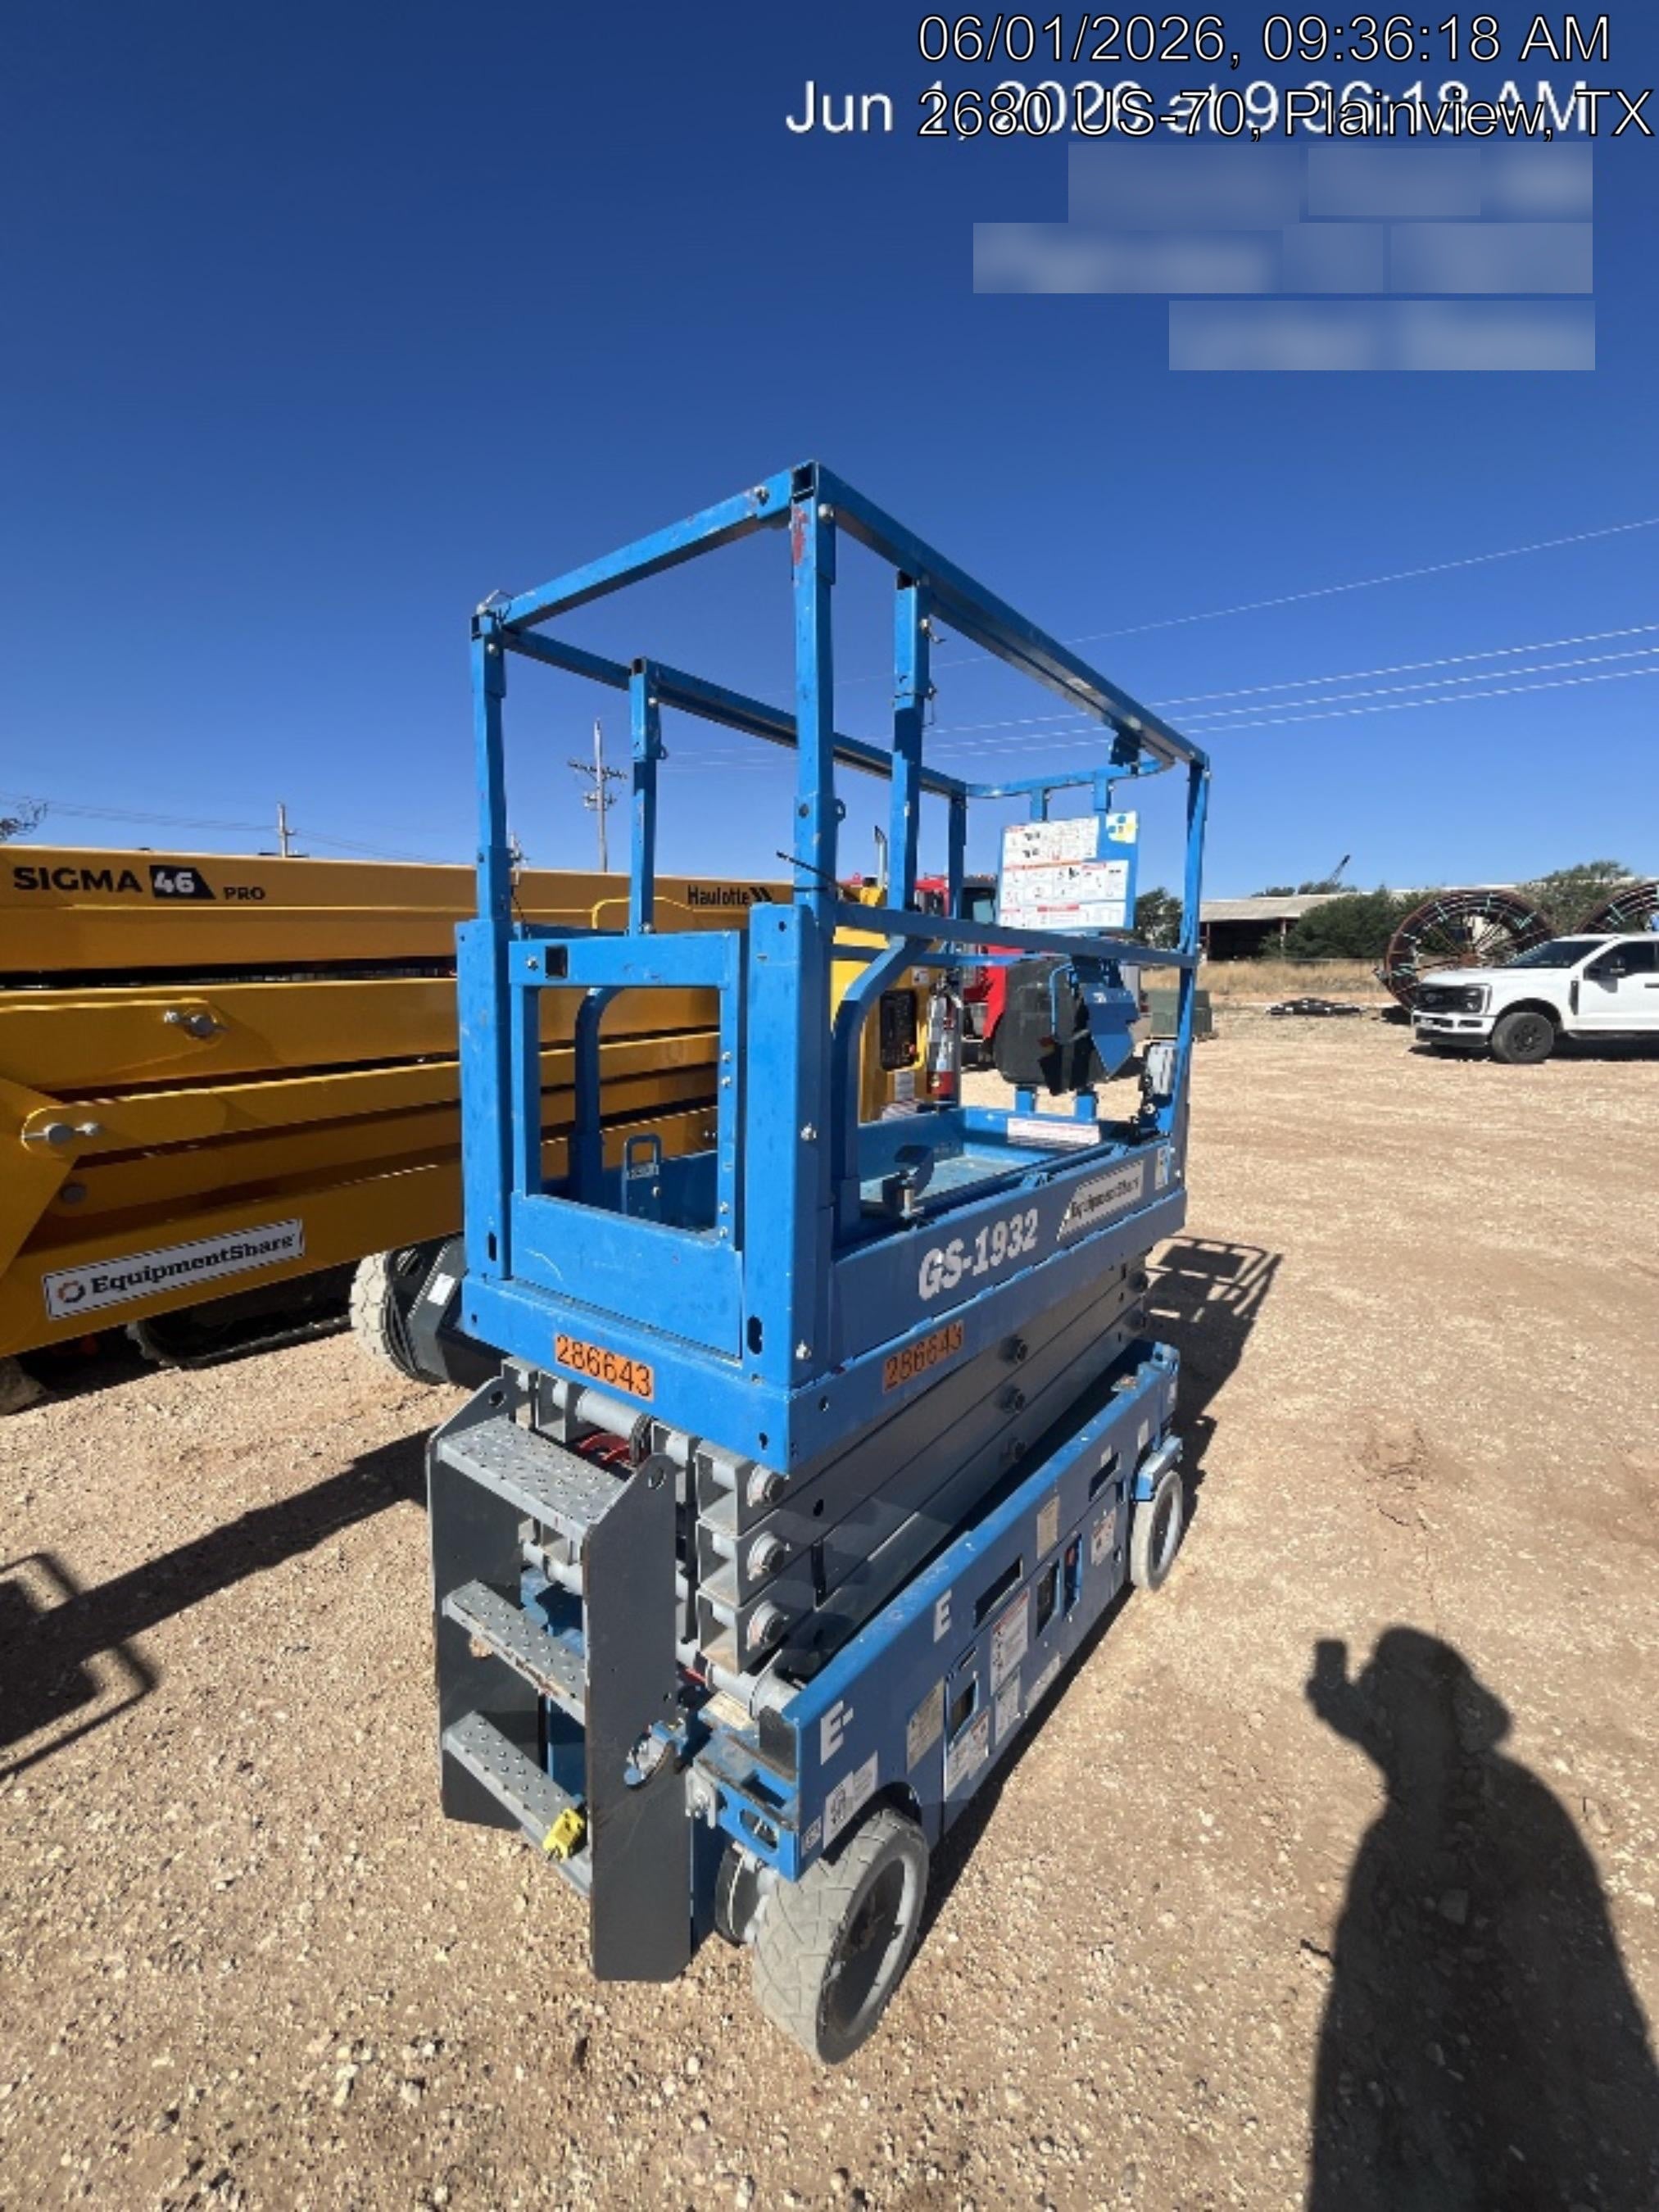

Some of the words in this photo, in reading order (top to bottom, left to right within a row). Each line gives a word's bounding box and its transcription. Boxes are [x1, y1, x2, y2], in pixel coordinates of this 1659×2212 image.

[12, 866, 143, 893] SIGMA
[153, 871, 196, 893] 46
[224, 886, 266, 900] PRO
[687, 884, 750, 905] Haulotte
[90, 1235, 295, 1294] EquipmentShare
[918, 1208, 1039, 1301] GS-1932
[556, 1334, 652, 1397] 286643
[884, 1322, 963, 1391] 286643
